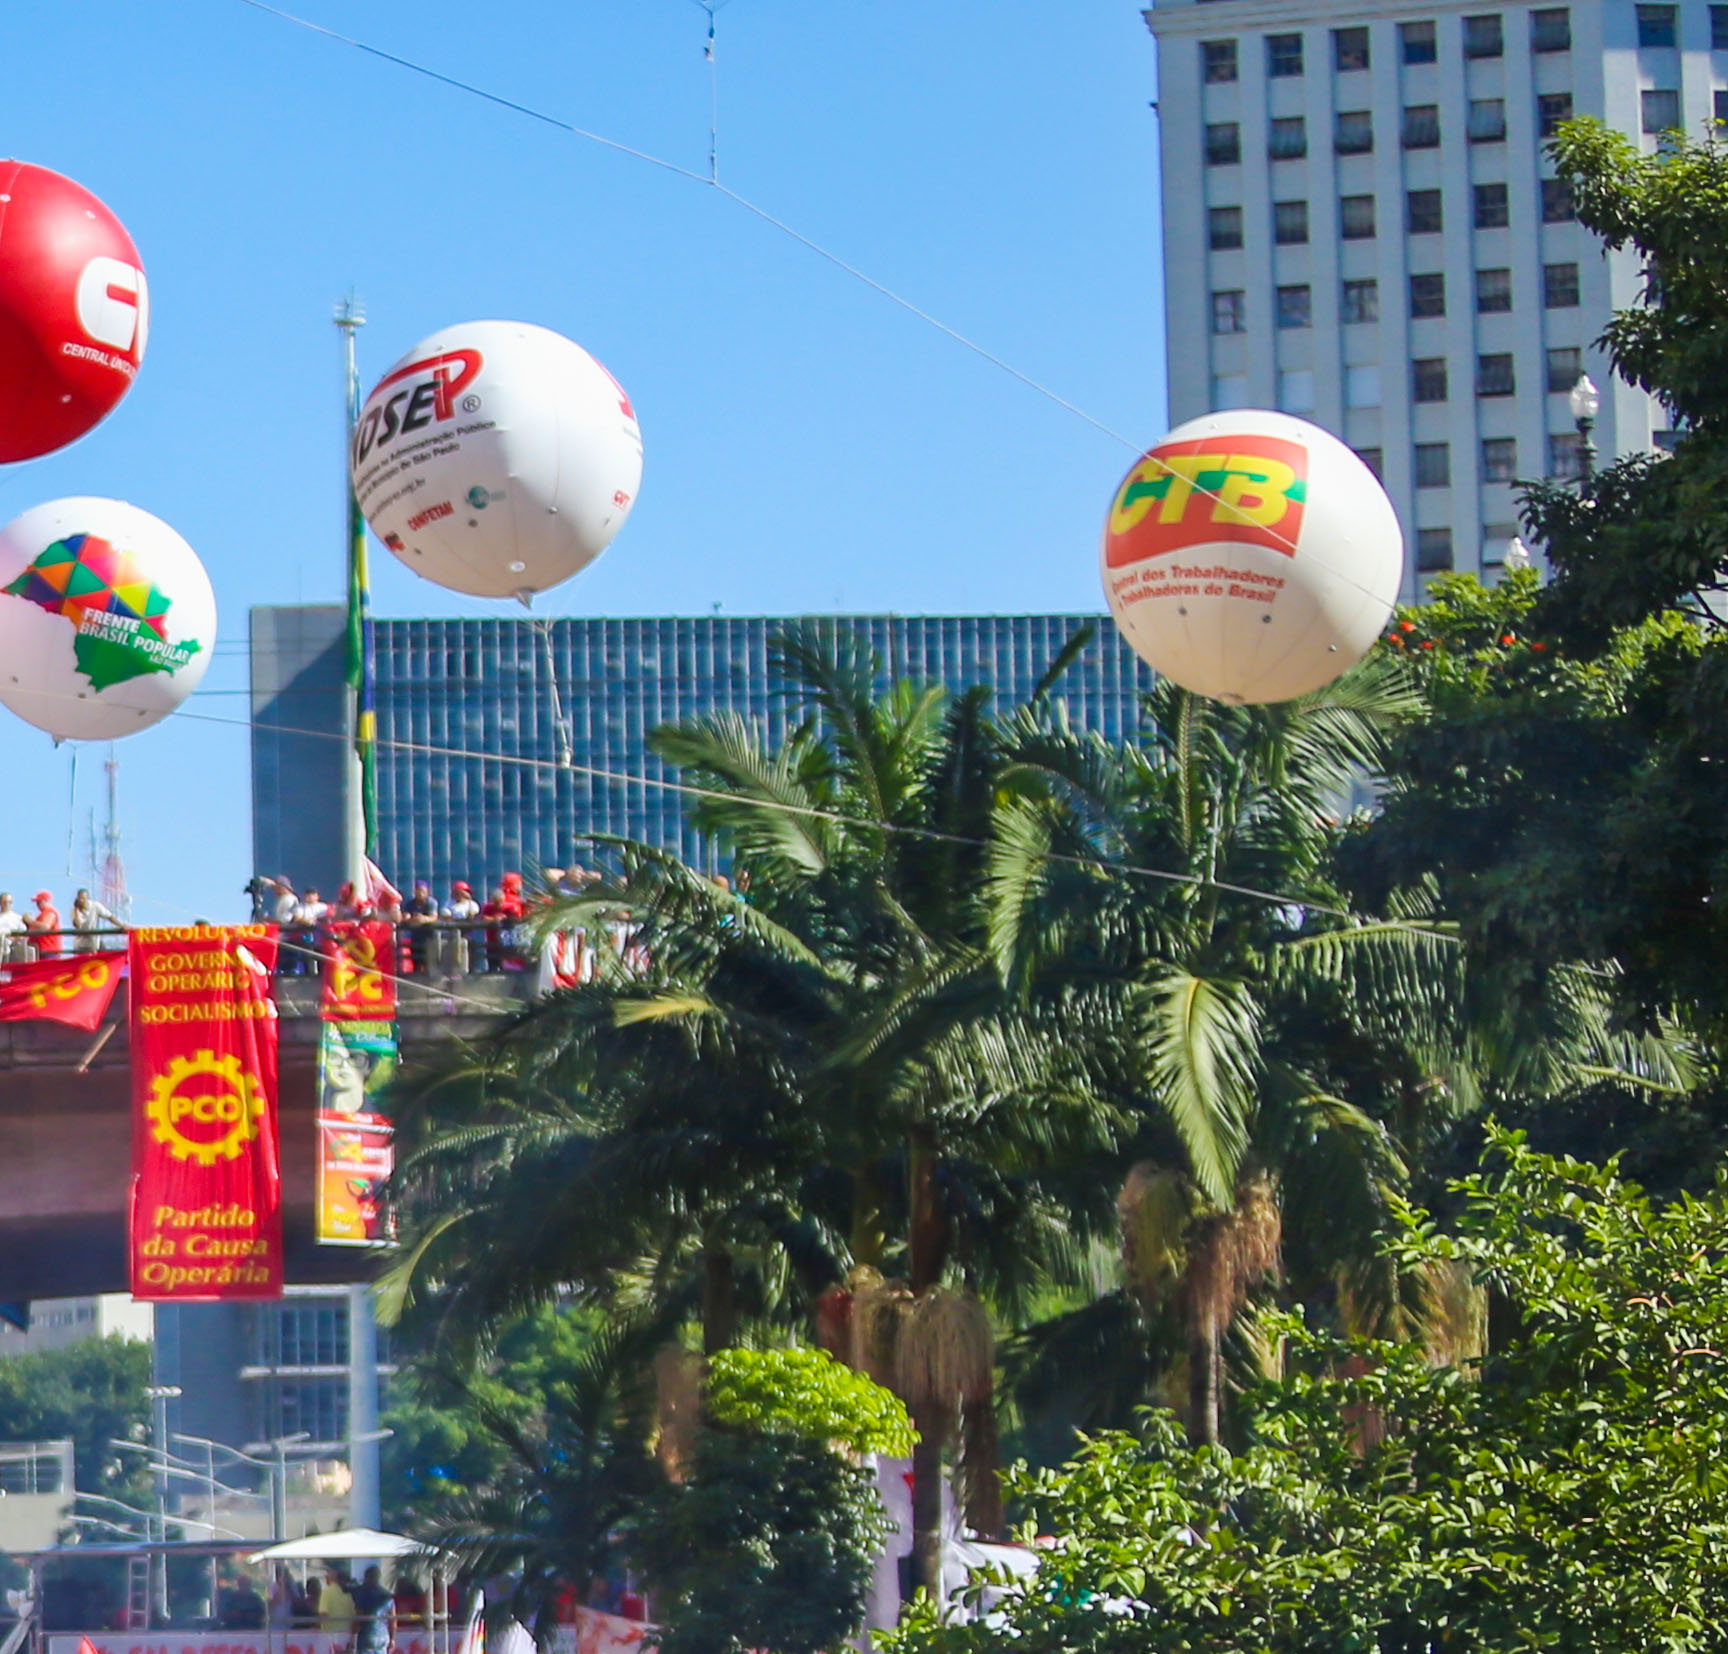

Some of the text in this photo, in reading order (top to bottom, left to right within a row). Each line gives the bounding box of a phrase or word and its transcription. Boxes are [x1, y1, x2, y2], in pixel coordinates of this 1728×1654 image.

[62, 342, 109, 367] CENTRAL
[1111, 453, 1296, 535] CTB
[1142, 568, 1166, 581] dos
[1171, 565, 1286, 590] Trabalhadores
[1205, 583, 1224, 596] do
[1228, 584, 1277, 605] Brasil
[83, 607, 141, 634] FRENTE
[79, 622, 190, 661] BRASIL POPULAR
[140, 1001, 268, 1026] SOCIALISMO
[170, 1096, 242, 1122] PCO
[154, 1203, 256, 1231] Partido
[144, 1235, 268, 1258] da Causa
[143, 1260, 270, 1291] Operária
